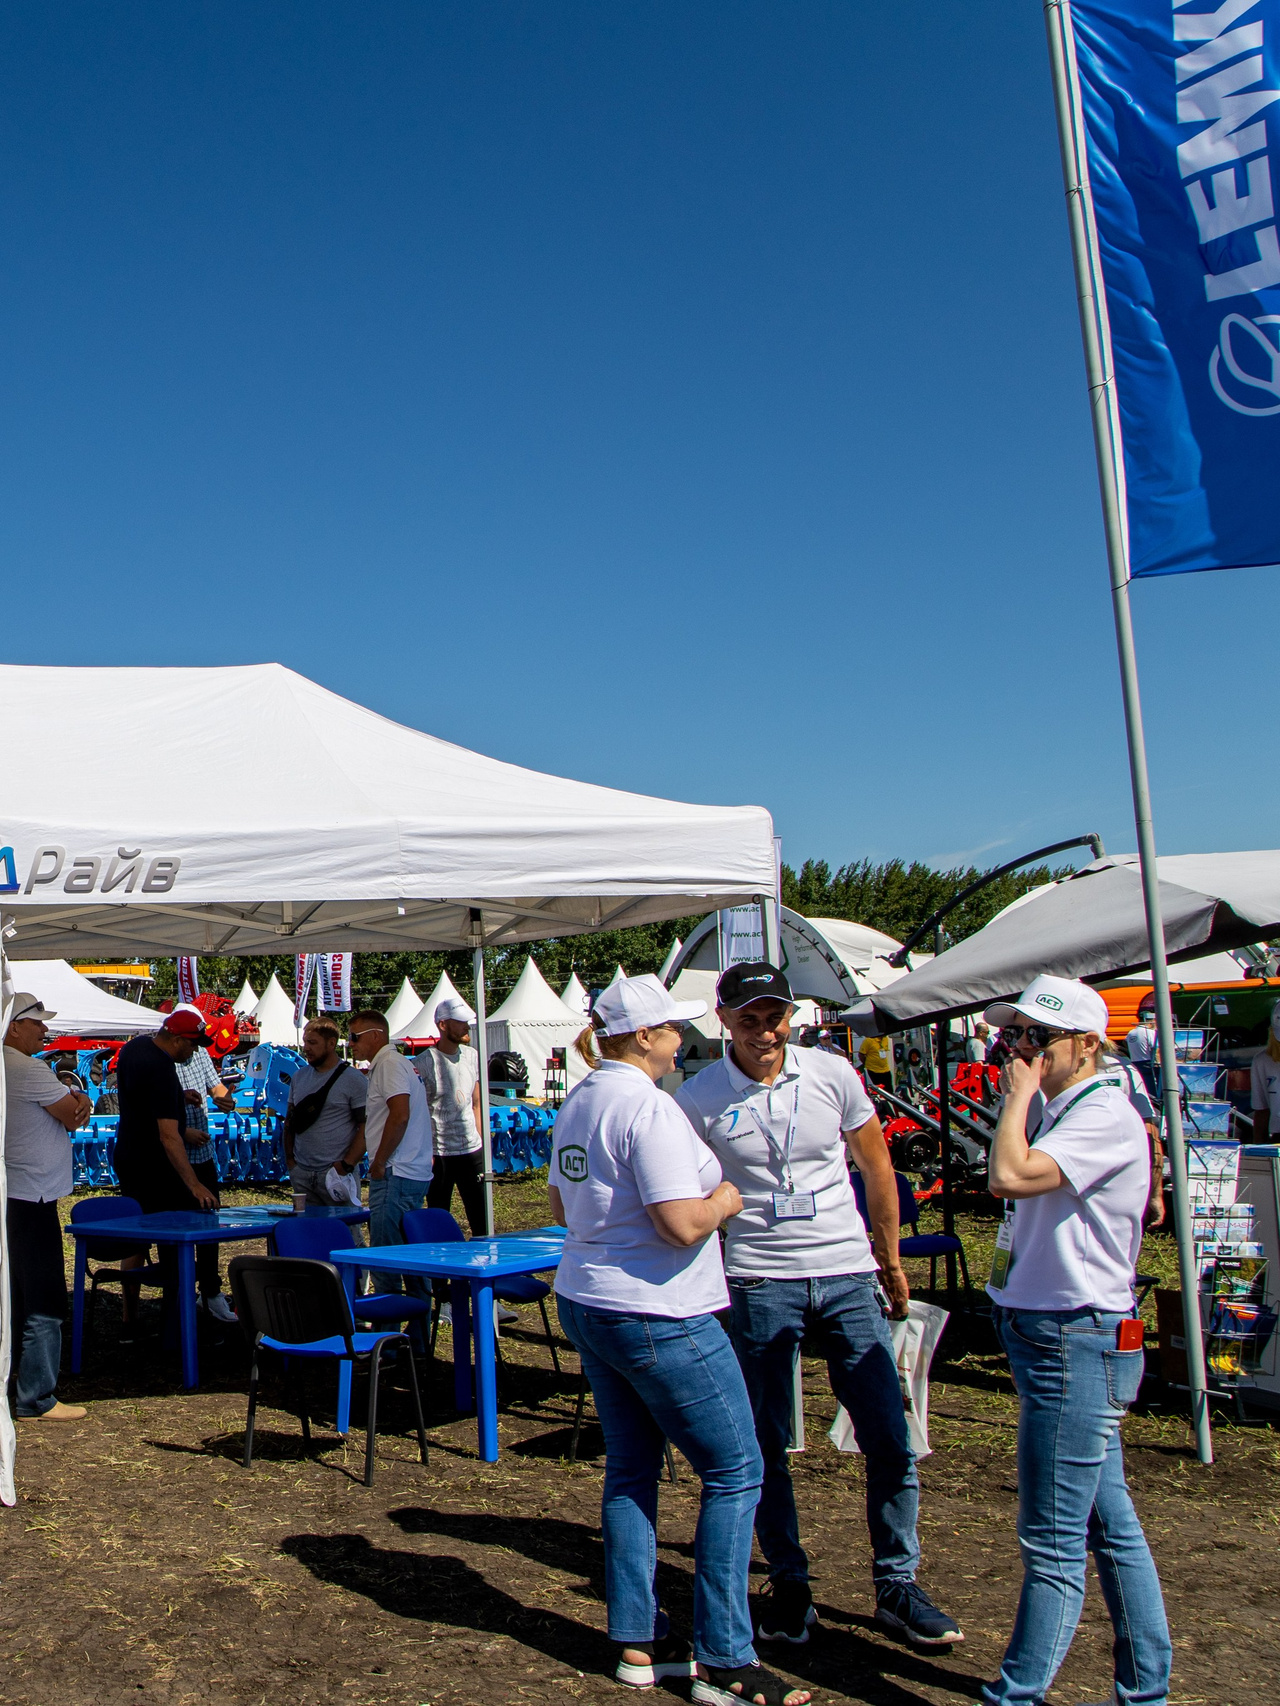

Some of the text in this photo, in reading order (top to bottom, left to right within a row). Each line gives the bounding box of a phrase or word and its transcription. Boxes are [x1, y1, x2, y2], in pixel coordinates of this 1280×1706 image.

[1172, 0, 1280, 302] LEMK
[1039, 997, 1060, 1008] ACT
[565, 1155, 585, 1173] ACT
